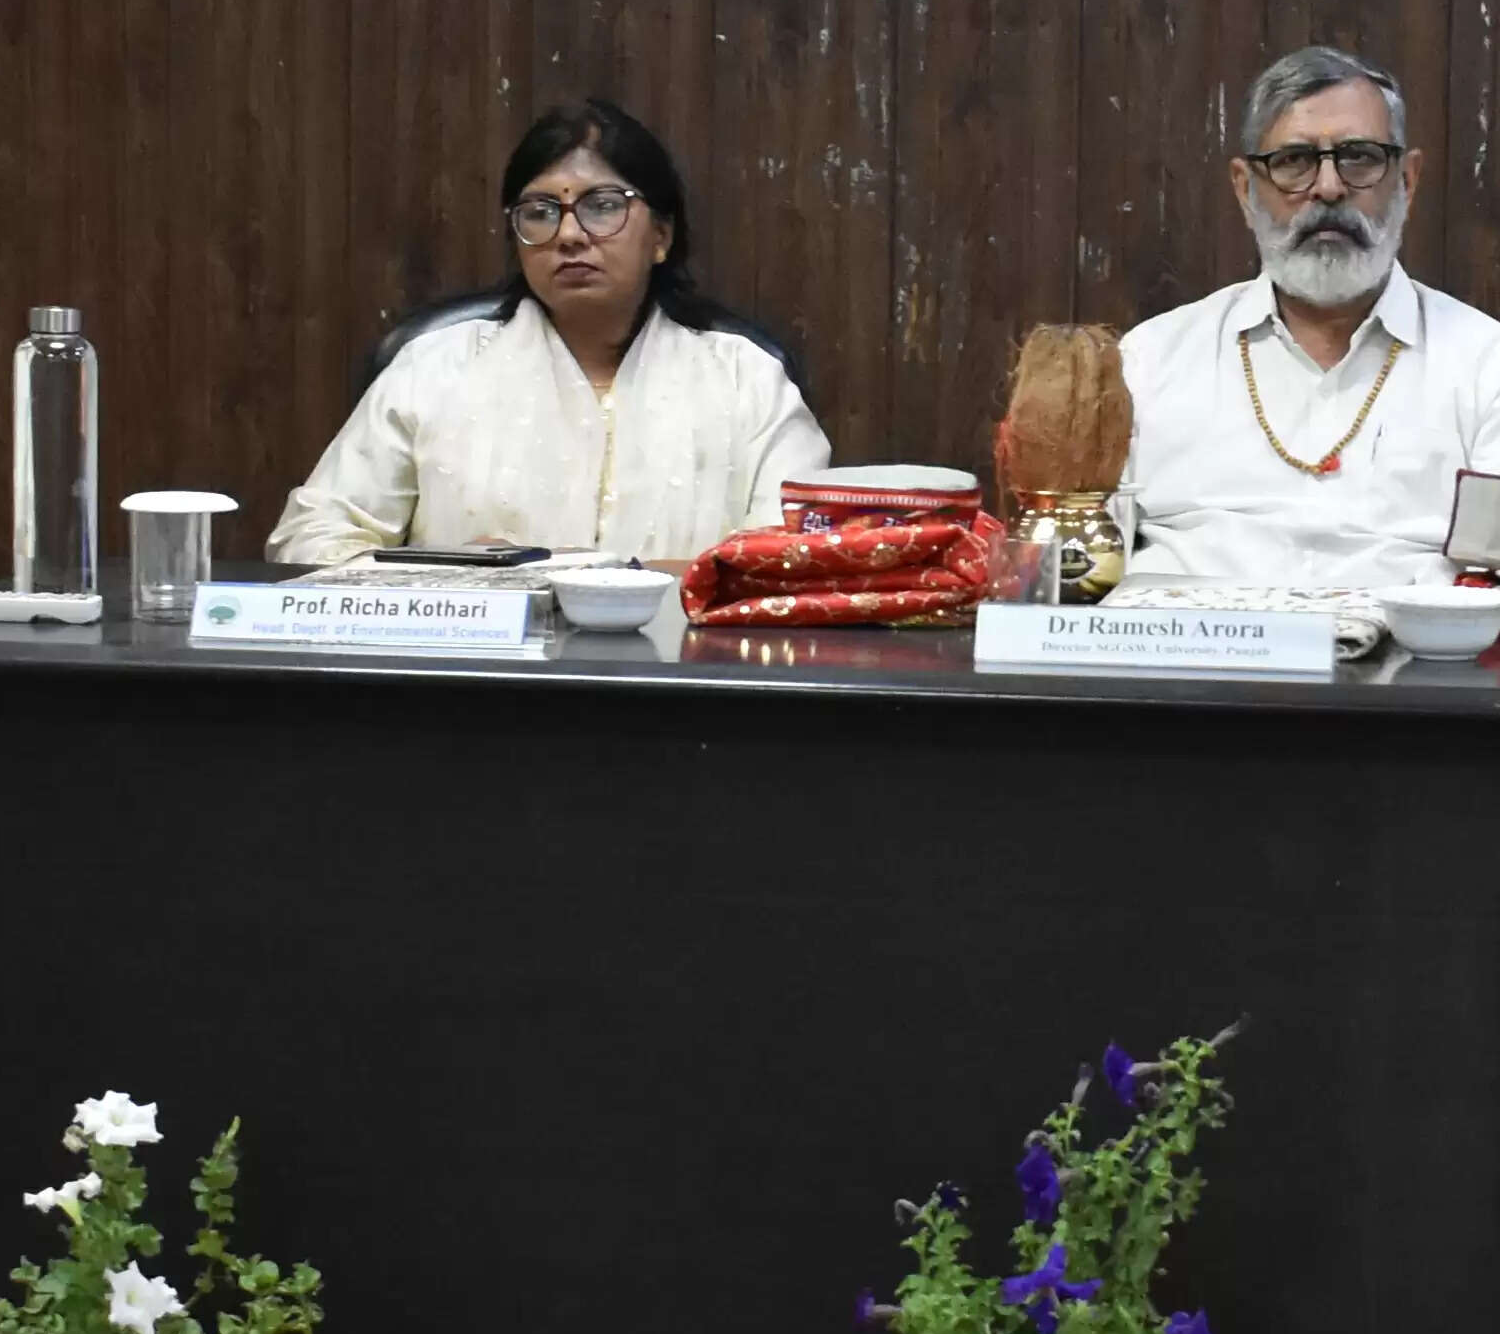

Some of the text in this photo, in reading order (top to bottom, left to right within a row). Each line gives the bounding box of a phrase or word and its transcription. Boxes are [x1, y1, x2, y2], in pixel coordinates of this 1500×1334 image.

[281, 595, 488, 618] Prof. Richa Kothari
[351, 624, 447, 638] Environmental
[452, 625, 510, 639] Sciences
[1048, 615, 1265, 639] Dr Ramesh Arora
